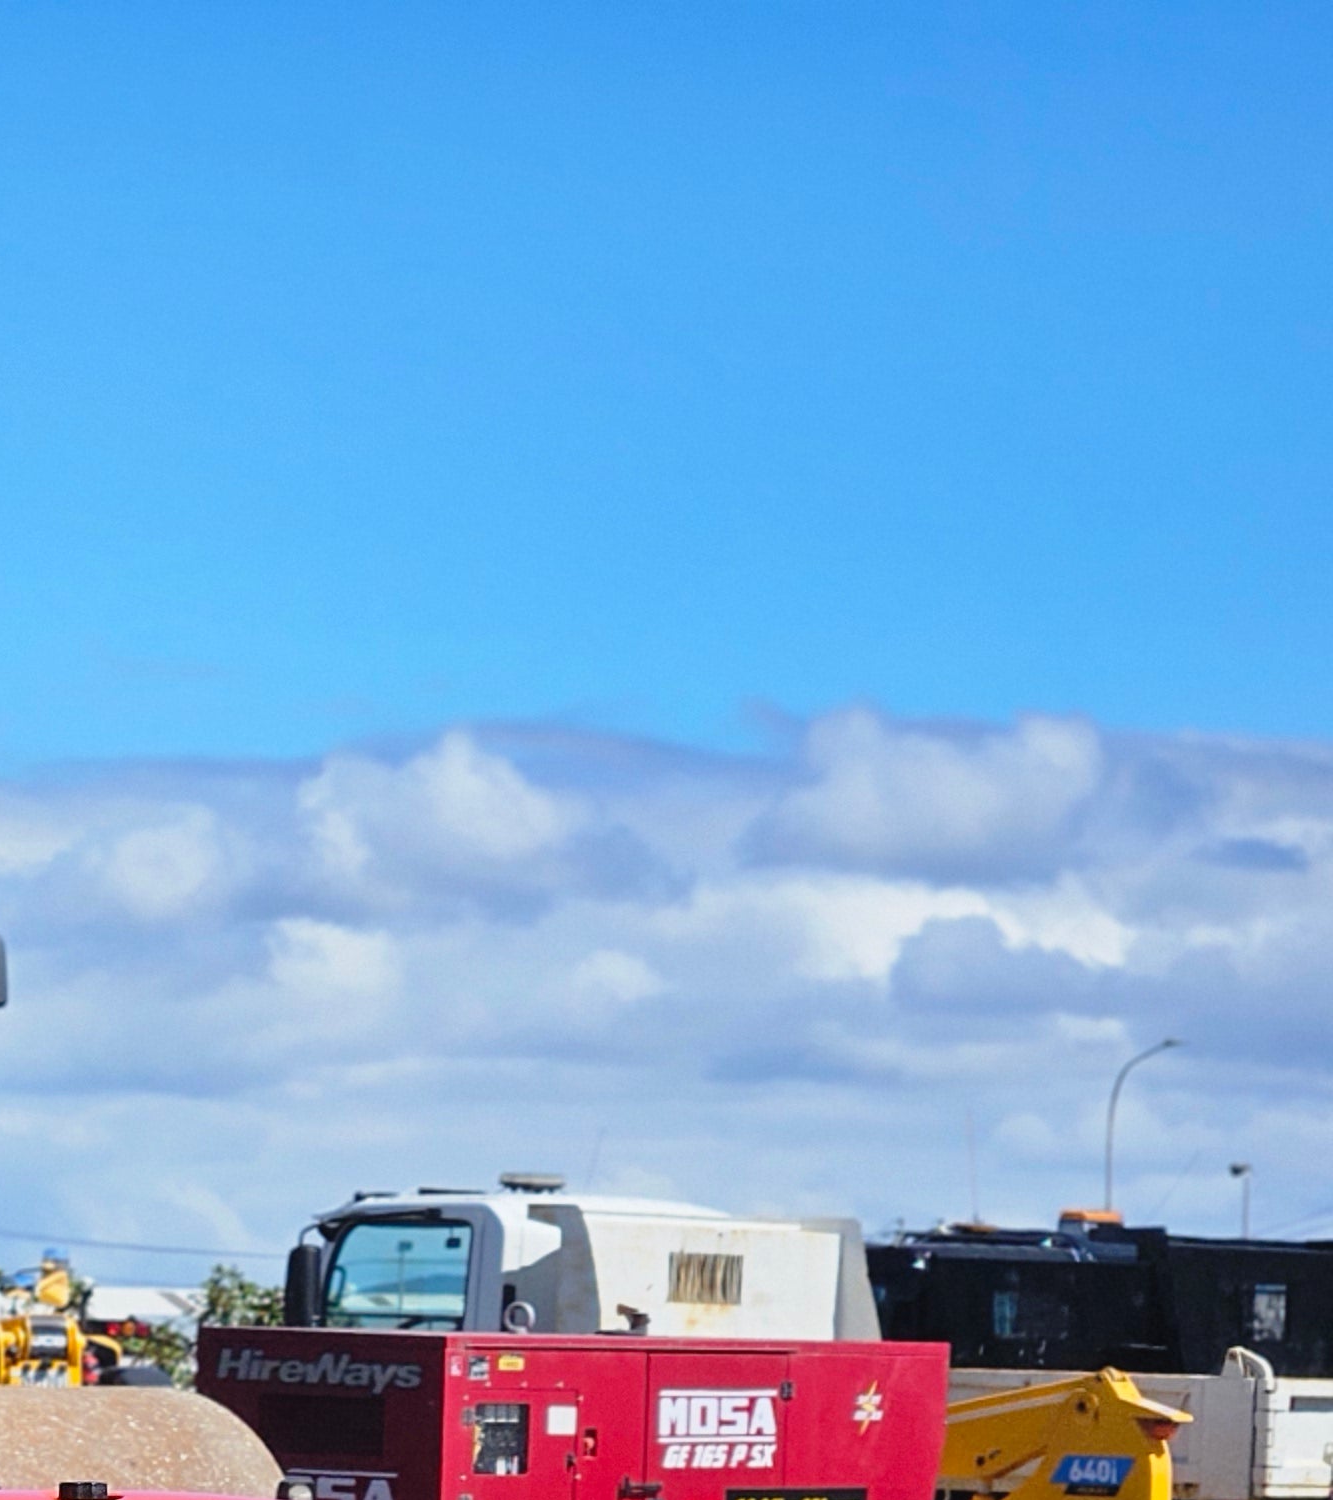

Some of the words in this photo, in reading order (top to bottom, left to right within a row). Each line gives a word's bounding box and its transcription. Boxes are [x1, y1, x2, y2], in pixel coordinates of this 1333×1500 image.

[216, 1347, 424, 1394] HireWays
[658, 1396, 777, 1436] MOSA
[661, 1444, 691, 1469] GE
[690, 1444, 729, 1469] 165
[729, 1444, 748, 1469] P
